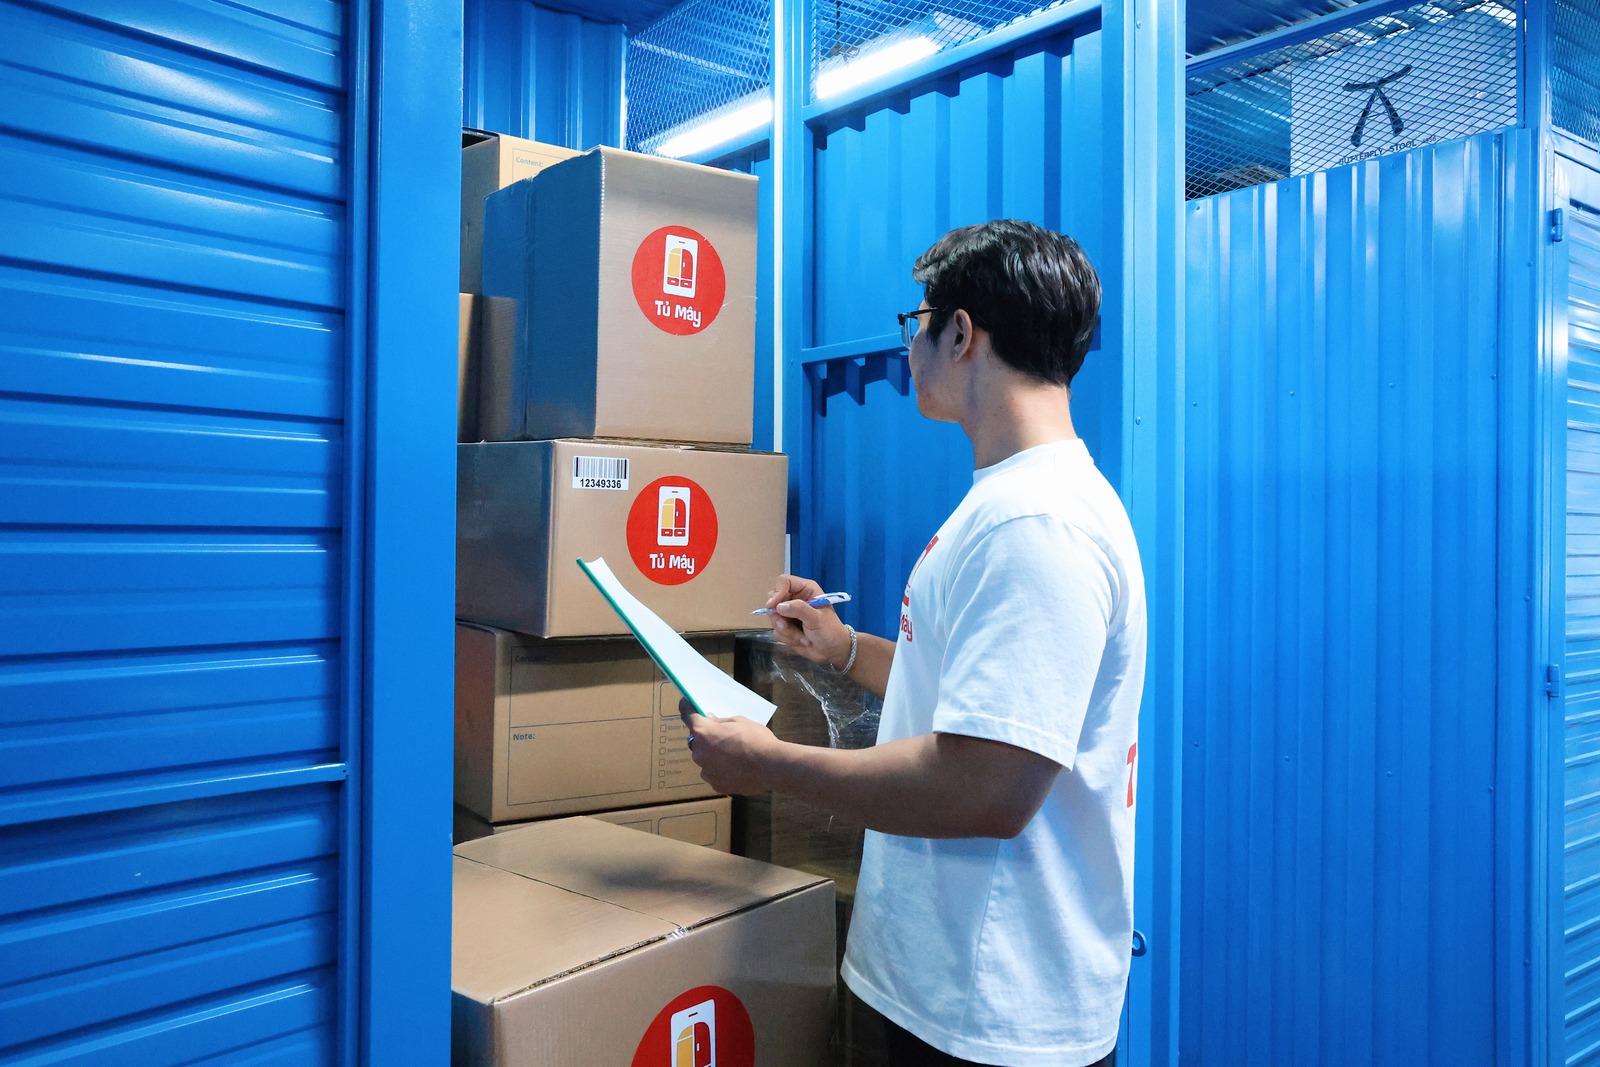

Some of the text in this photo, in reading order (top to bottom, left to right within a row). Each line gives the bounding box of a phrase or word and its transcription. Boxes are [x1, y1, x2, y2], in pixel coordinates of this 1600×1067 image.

[1389, 139, 1416, 153] STOOL
[515, 156, 543, 168] Content:
[655, 299, 701, 328] Tủ Mây
[580, 478, 622, 489] 12349336
[649, 552, 695, 575] Tủ Mây
[513, 732, 536, 741] Note:
